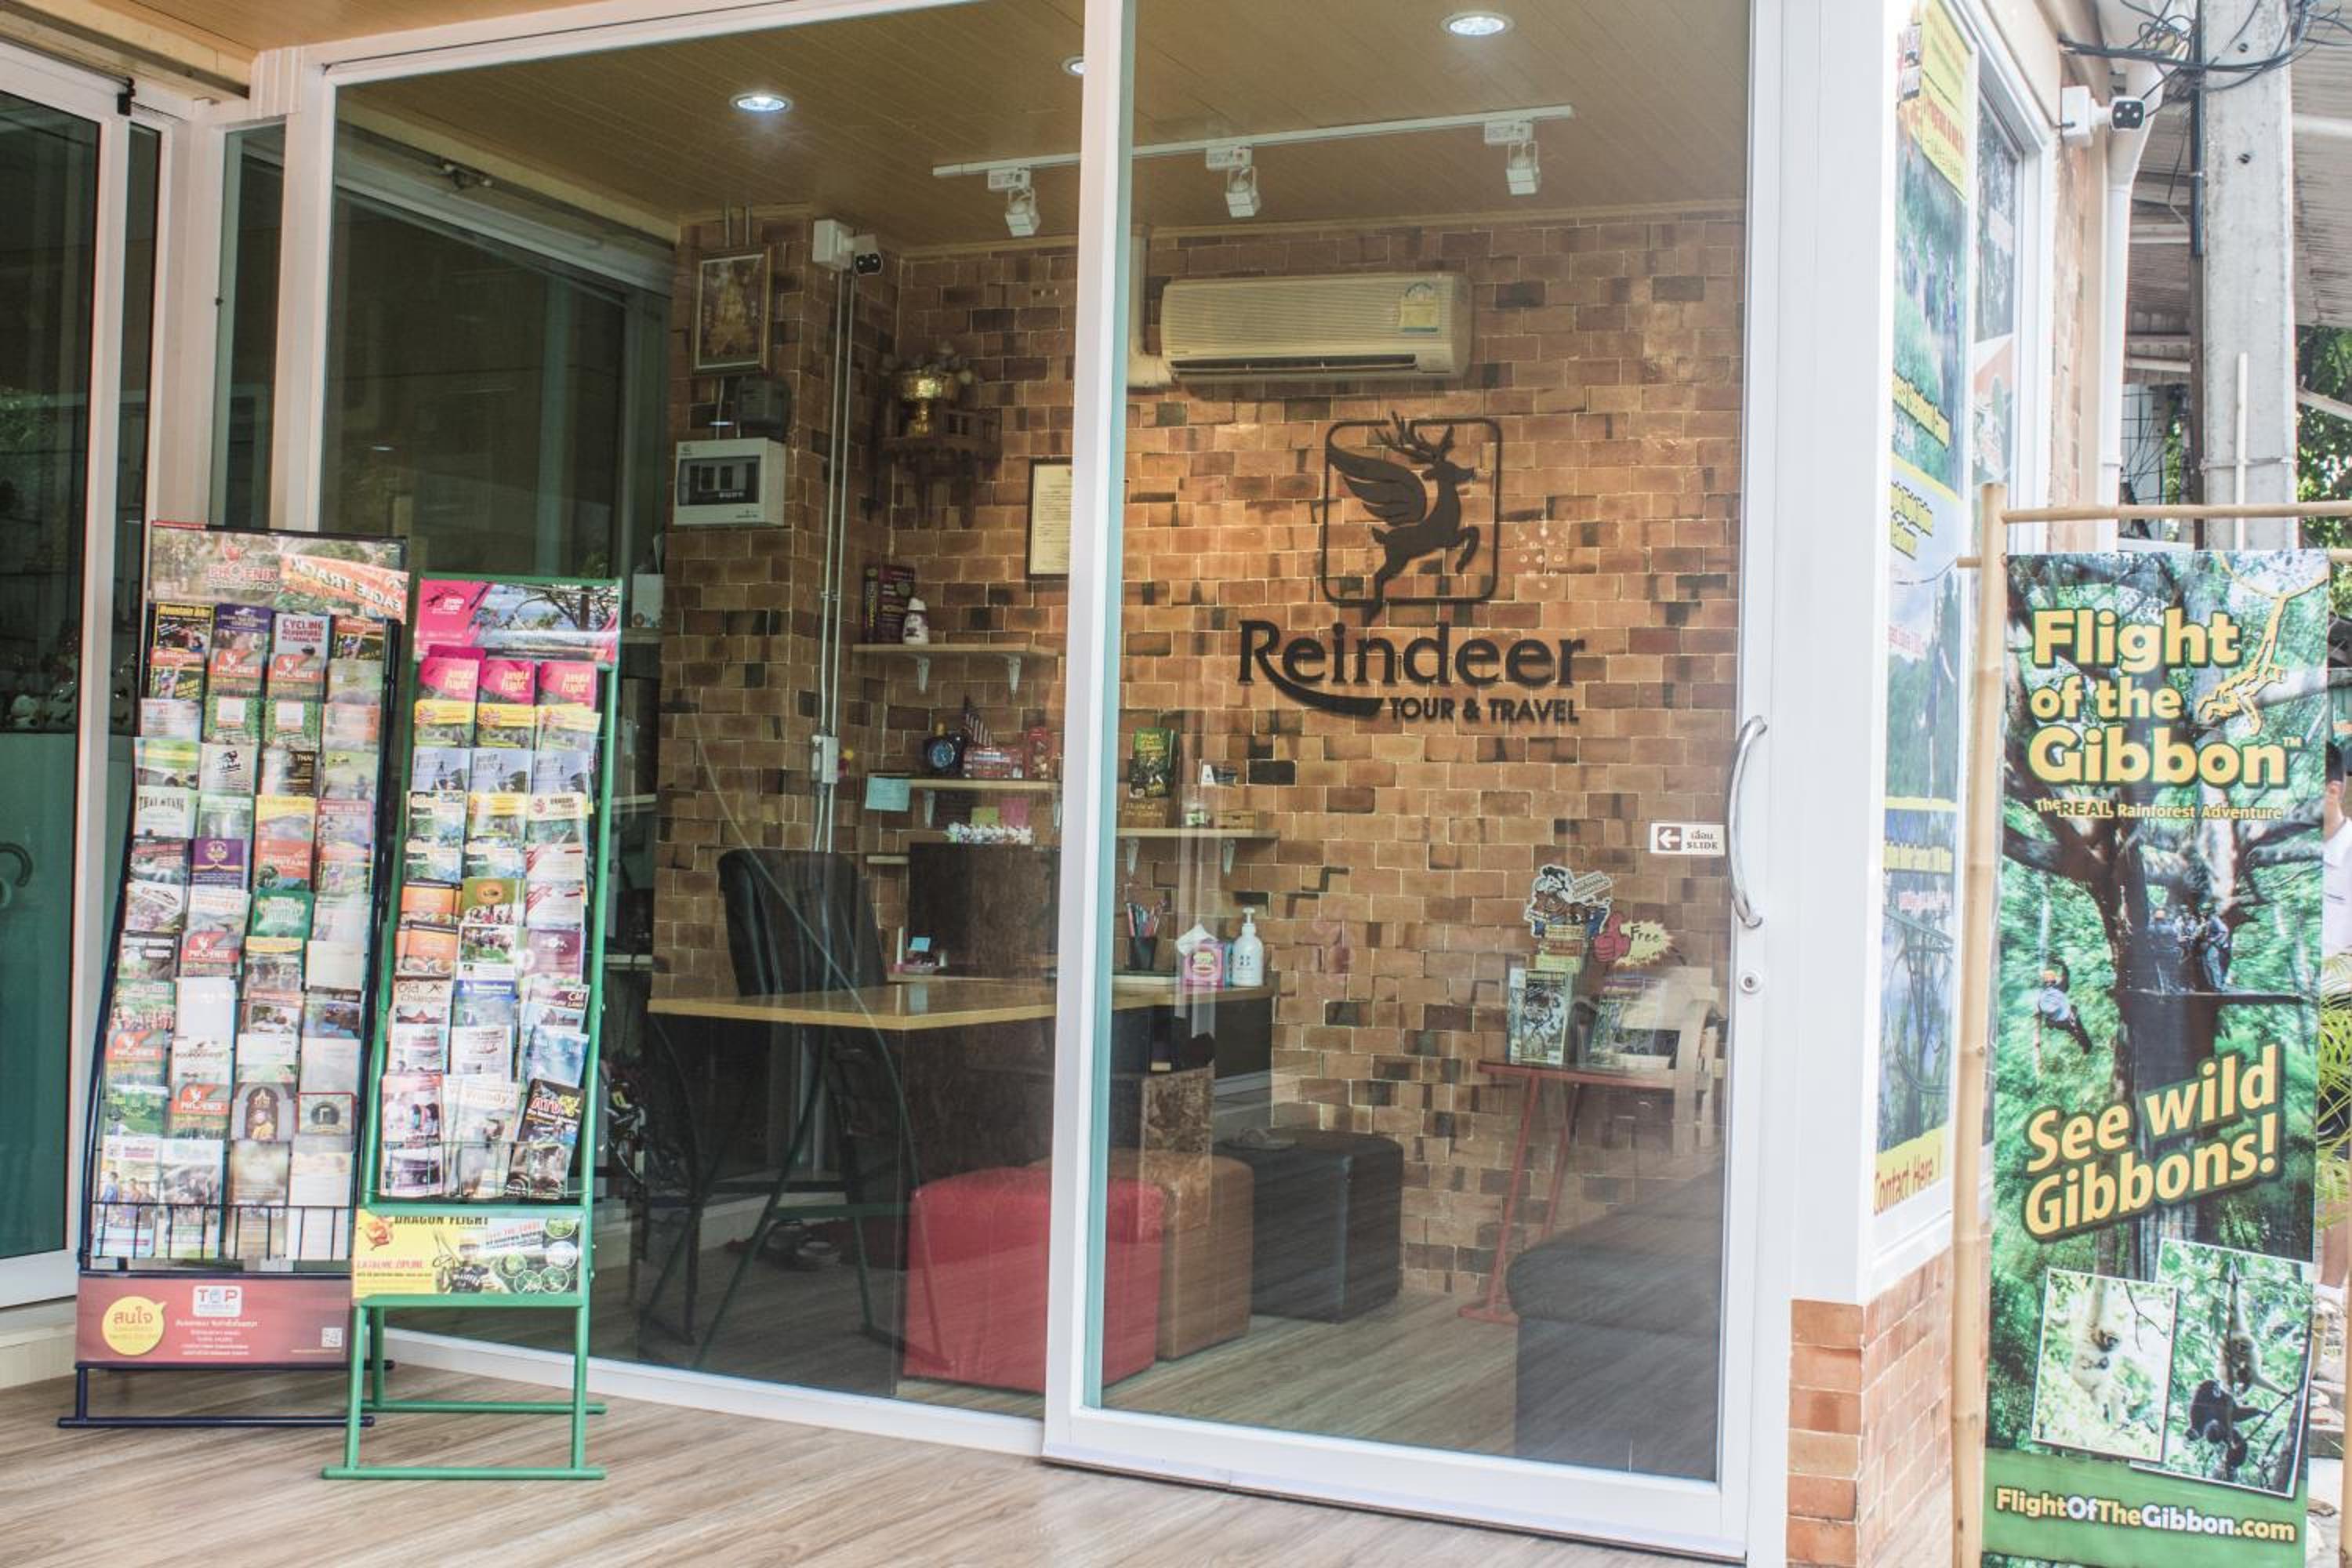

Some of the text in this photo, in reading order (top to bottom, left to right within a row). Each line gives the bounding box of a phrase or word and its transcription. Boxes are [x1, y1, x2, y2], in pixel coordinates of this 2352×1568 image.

[282, 618, 324, 629] CYCLING
[2031, 607, 2242, 674] Flight
[1238, 619, 1585, 717] Reindeer
[1389, 698, 1580, 724] TOUR & TRAVEL
[2031, 675, 2184, 721] of the
[2027, 724, 2288, 789] Gibbon
[2036, 798, 2283, 820] The REAL Rainforest Adventure
[1686, 841, 1719, 850] SLIDE
[1630, 924, 1661, 942] Free
[2027, 1043, 2278, 1174] See wild
[1875, 1160, 1909, 1216] Contact
[1914, 1154, 1933, 1192] Here
[2024, 1112, 2278, 1236] Gibbons!
[1994, 1485, 2296, 1543] FlightOfTheGibbon.com
